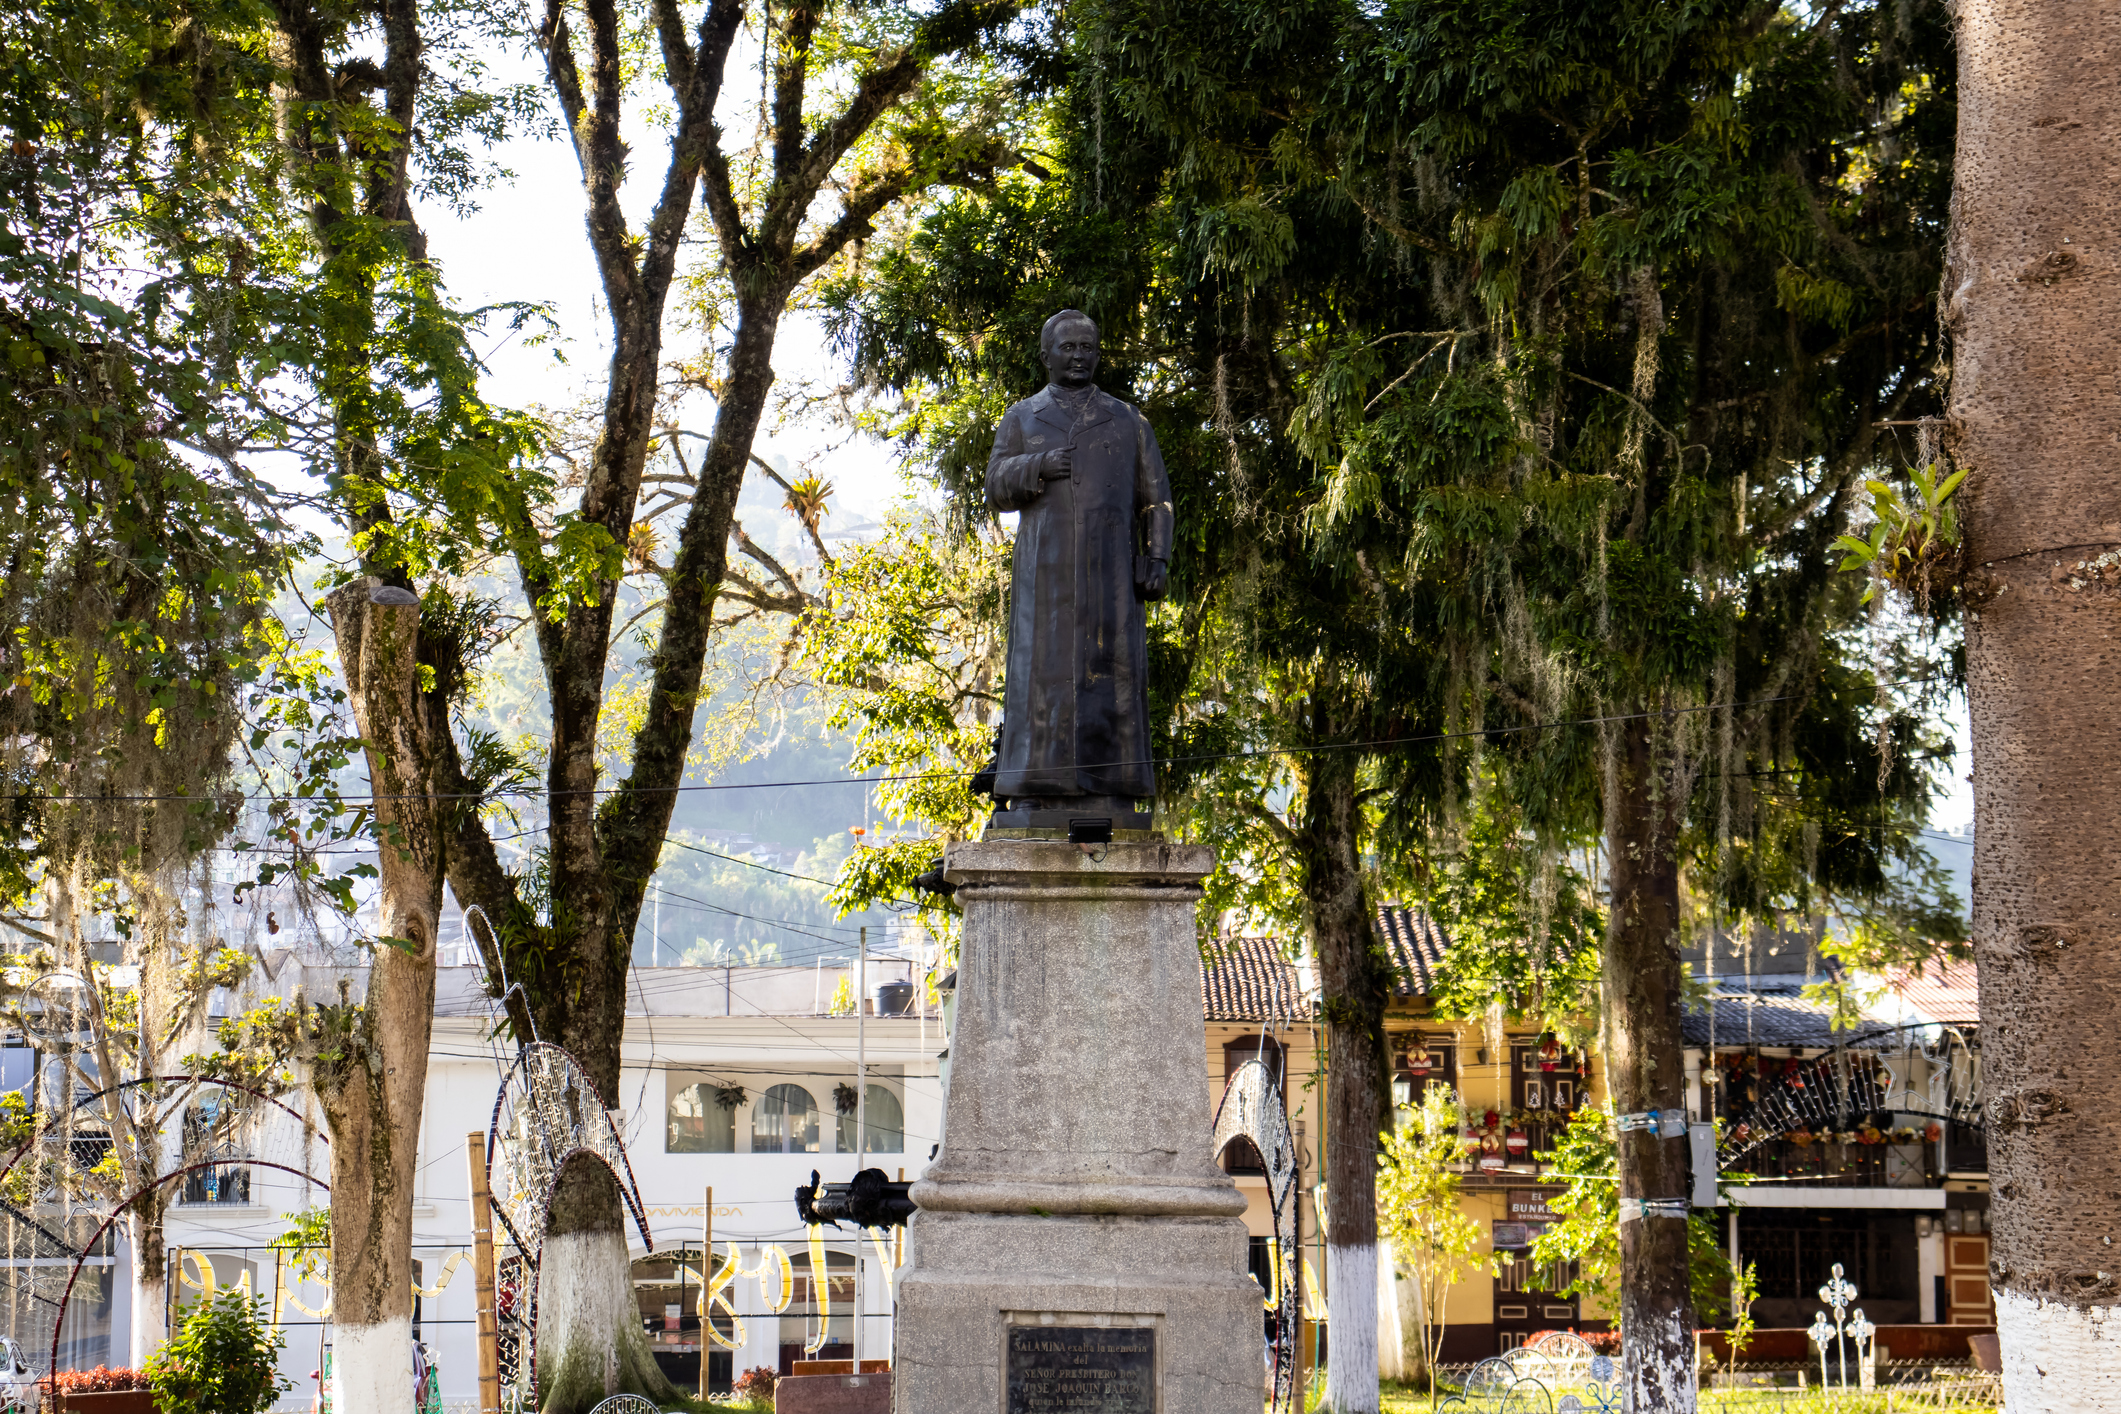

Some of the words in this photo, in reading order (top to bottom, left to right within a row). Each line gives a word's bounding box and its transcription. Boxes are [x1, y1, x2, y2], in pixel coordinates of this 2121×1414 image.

[1531, 1193, 1544, 1201] EL
[1512, 1204, 1562, 1213] BUNKE
[1015, 1341, 1066, 1352] SALAMINA
[1067, 1342, 1094, 1353] exalta
[1097, 1342, 1106, 1353] la
[1107, 1344, 1147, 1353] memoria
[1073, 1354, 1088, 1365] del
[1024, 1367, 1056, 1379] SEÑOR
[1058, 1368, 1117, 1379] PRESBITERO
[1120, 1369, 1138, 1379] DON
[1022, 1382, 1050, 1394] JOSE
[1055, 1382, 1101, 1394] JOAQUIN
[1104, 1383, 1140, 1394] BARCO
[1028, 1396, 1054, 1409] quien
[1056, 1395, 1064, 1406] le
